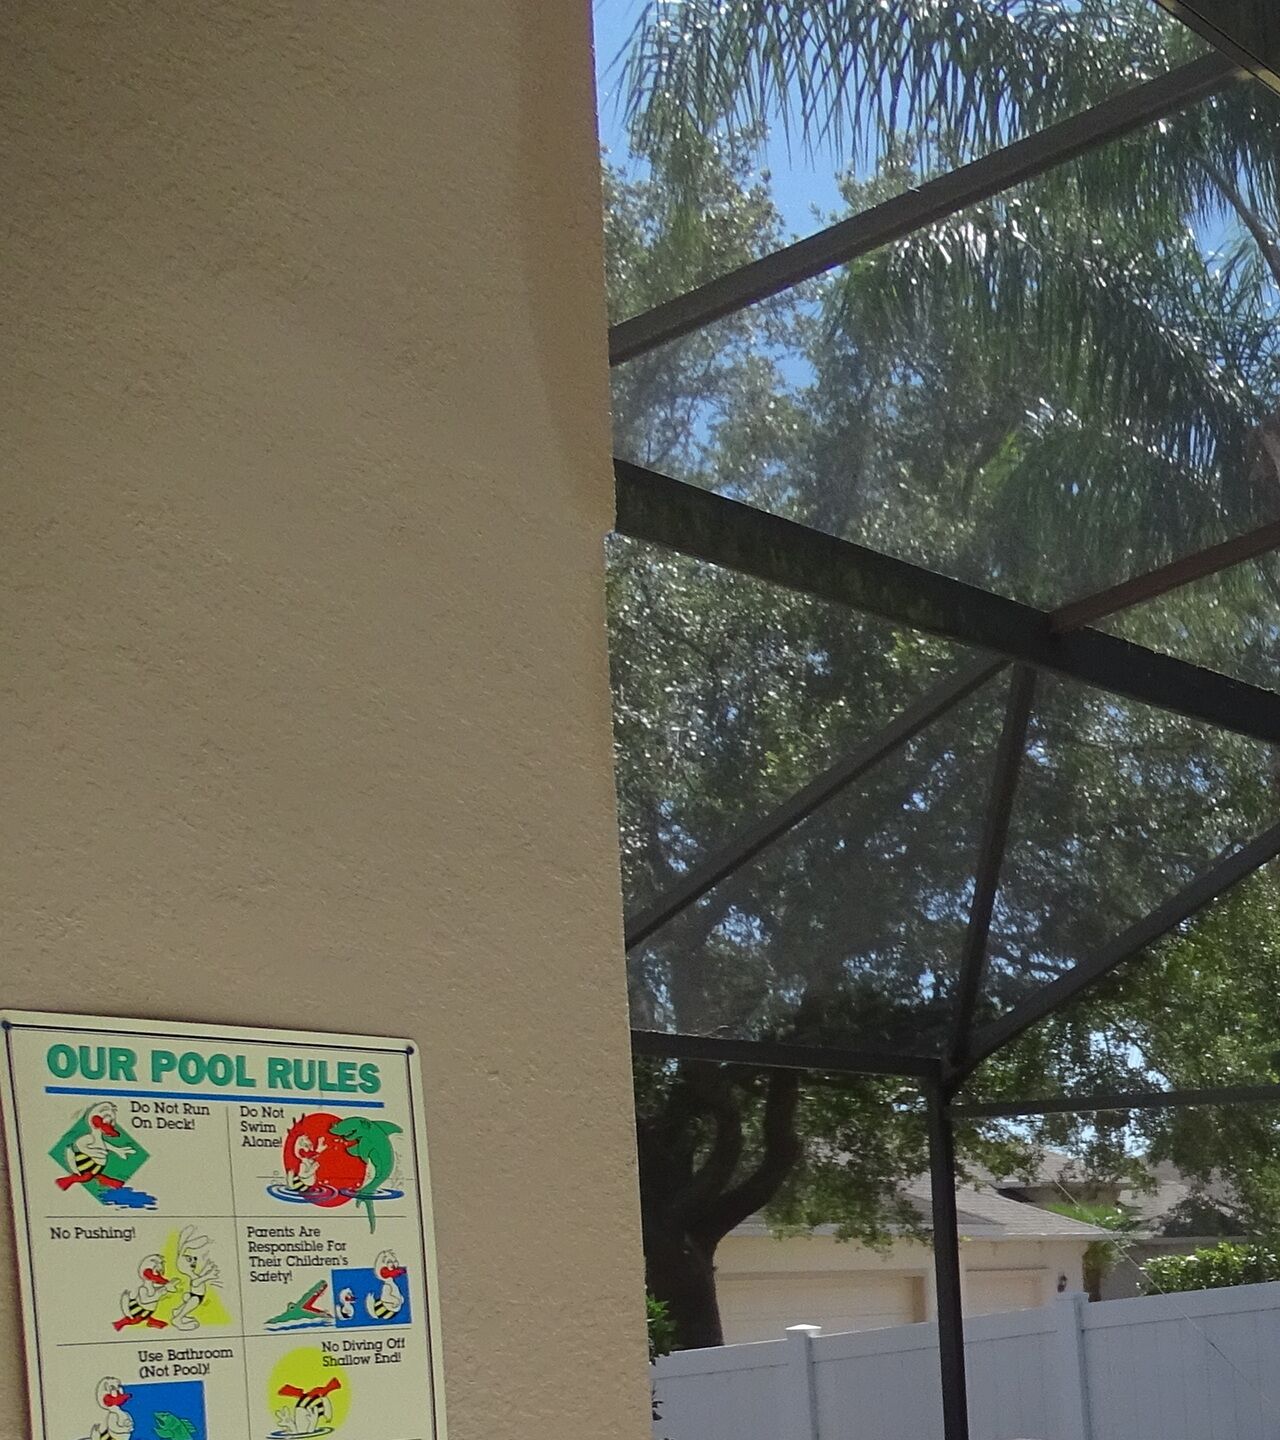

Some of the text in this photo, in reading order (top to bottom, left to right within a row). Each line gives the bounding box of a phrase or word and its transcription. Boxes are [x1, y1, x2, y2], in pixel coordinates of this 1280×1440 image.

[47, 1043, 382, 1095] OUR POOL RULES
[130, 1101, 210, 1116] Do Not Run
[240, 1106, 285, 1119] Do Not
[131, 1117, 195, 1130] On Deck!
[240, 1121, 277, 1133] Swim
[242, 1136, 283, 1148] Alone!
[50, 1226, 136, 1242] No Pushing!
[247, 1226, 321, 1238] Parents Are
[248, 1240, 347, 1255] Responsible For
[249, 1255, 349, 1267] Their Children's
[250, 1270, 293, 1284] Safety!
[321, 1337, 405, 1352] No Diving Off
[138, 1348, 233, 1362] Use Bathroom
[322, 1352, 402, 1367] Shallow End!
[139, 1363, 211, 1379] (Not Pool)!
